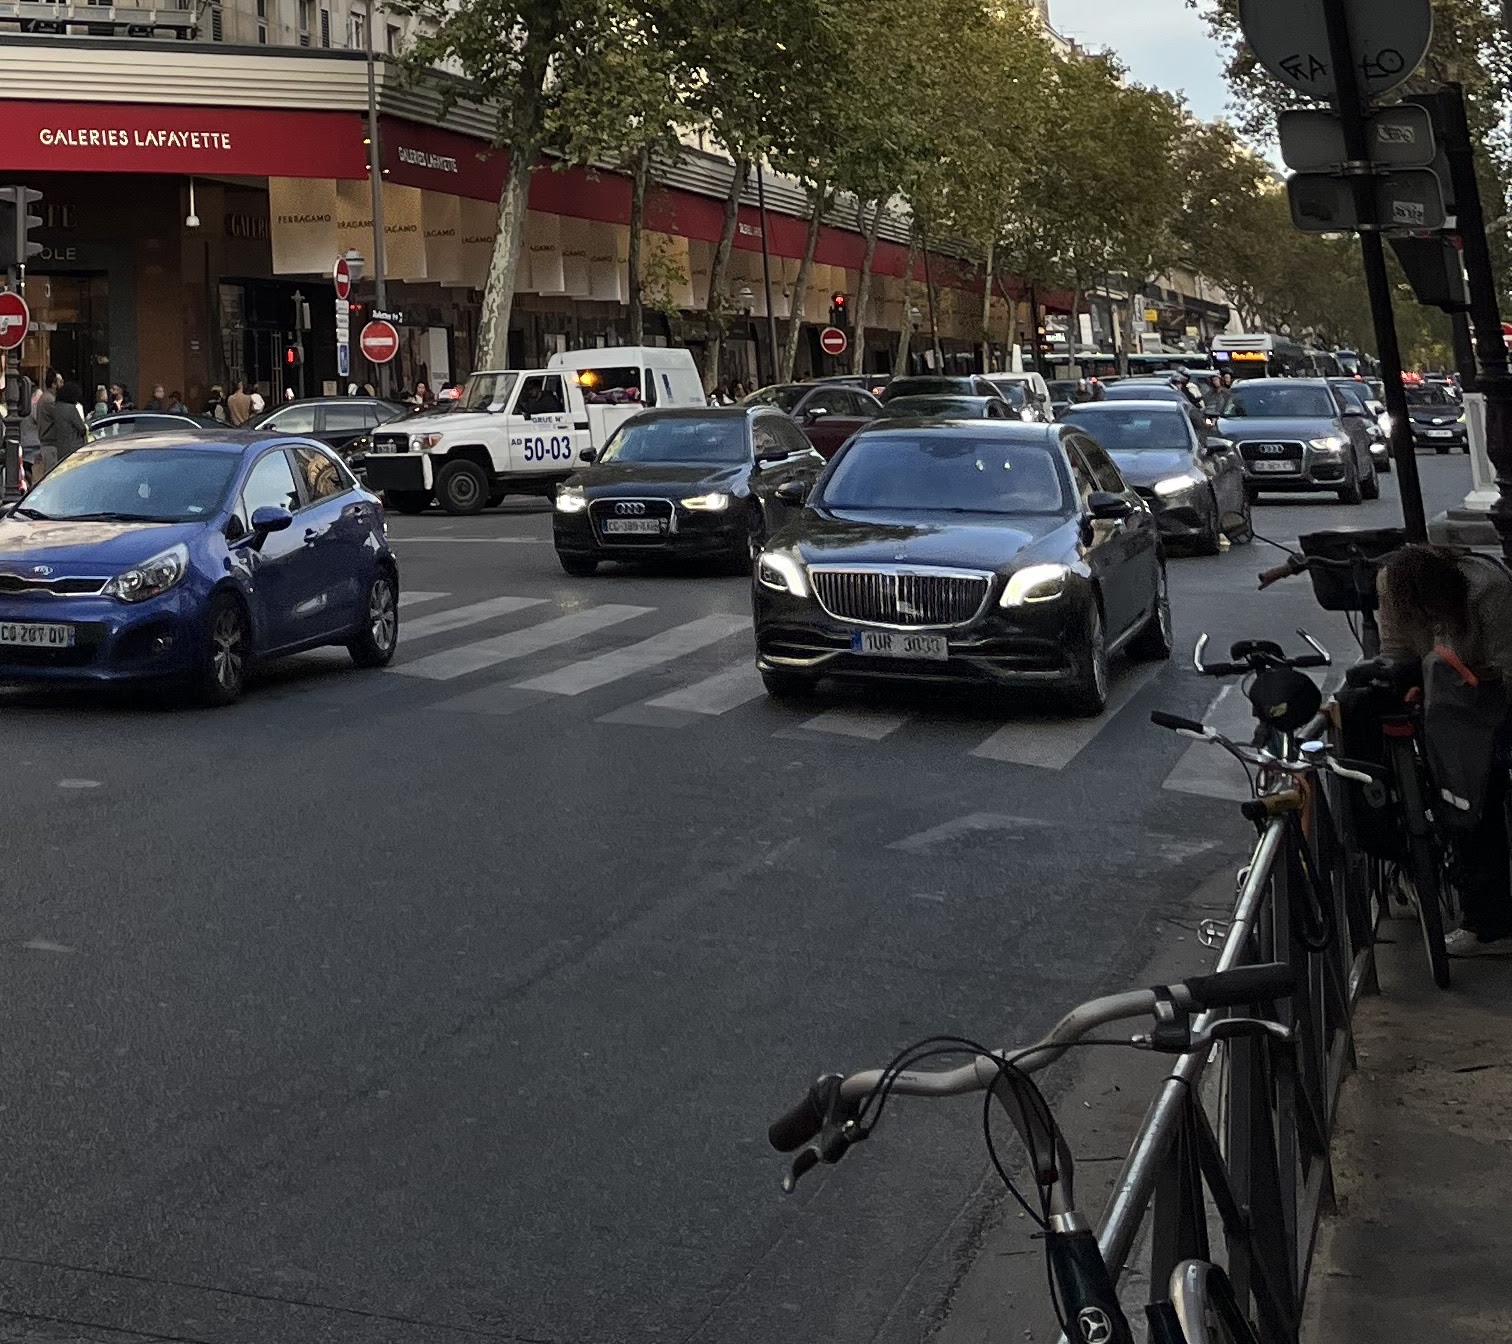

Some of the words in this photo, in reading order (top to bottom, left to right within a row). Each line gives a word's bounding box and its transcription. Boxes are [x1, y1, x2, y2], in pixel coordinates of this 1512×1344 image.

[39, 128, 129, 147] GALERIES
[133, 130, 232, 150] LAFAYETTE
[277, 213, 332, 224] FERRAGAMO
[524, 435, 572, 462] 50-03
